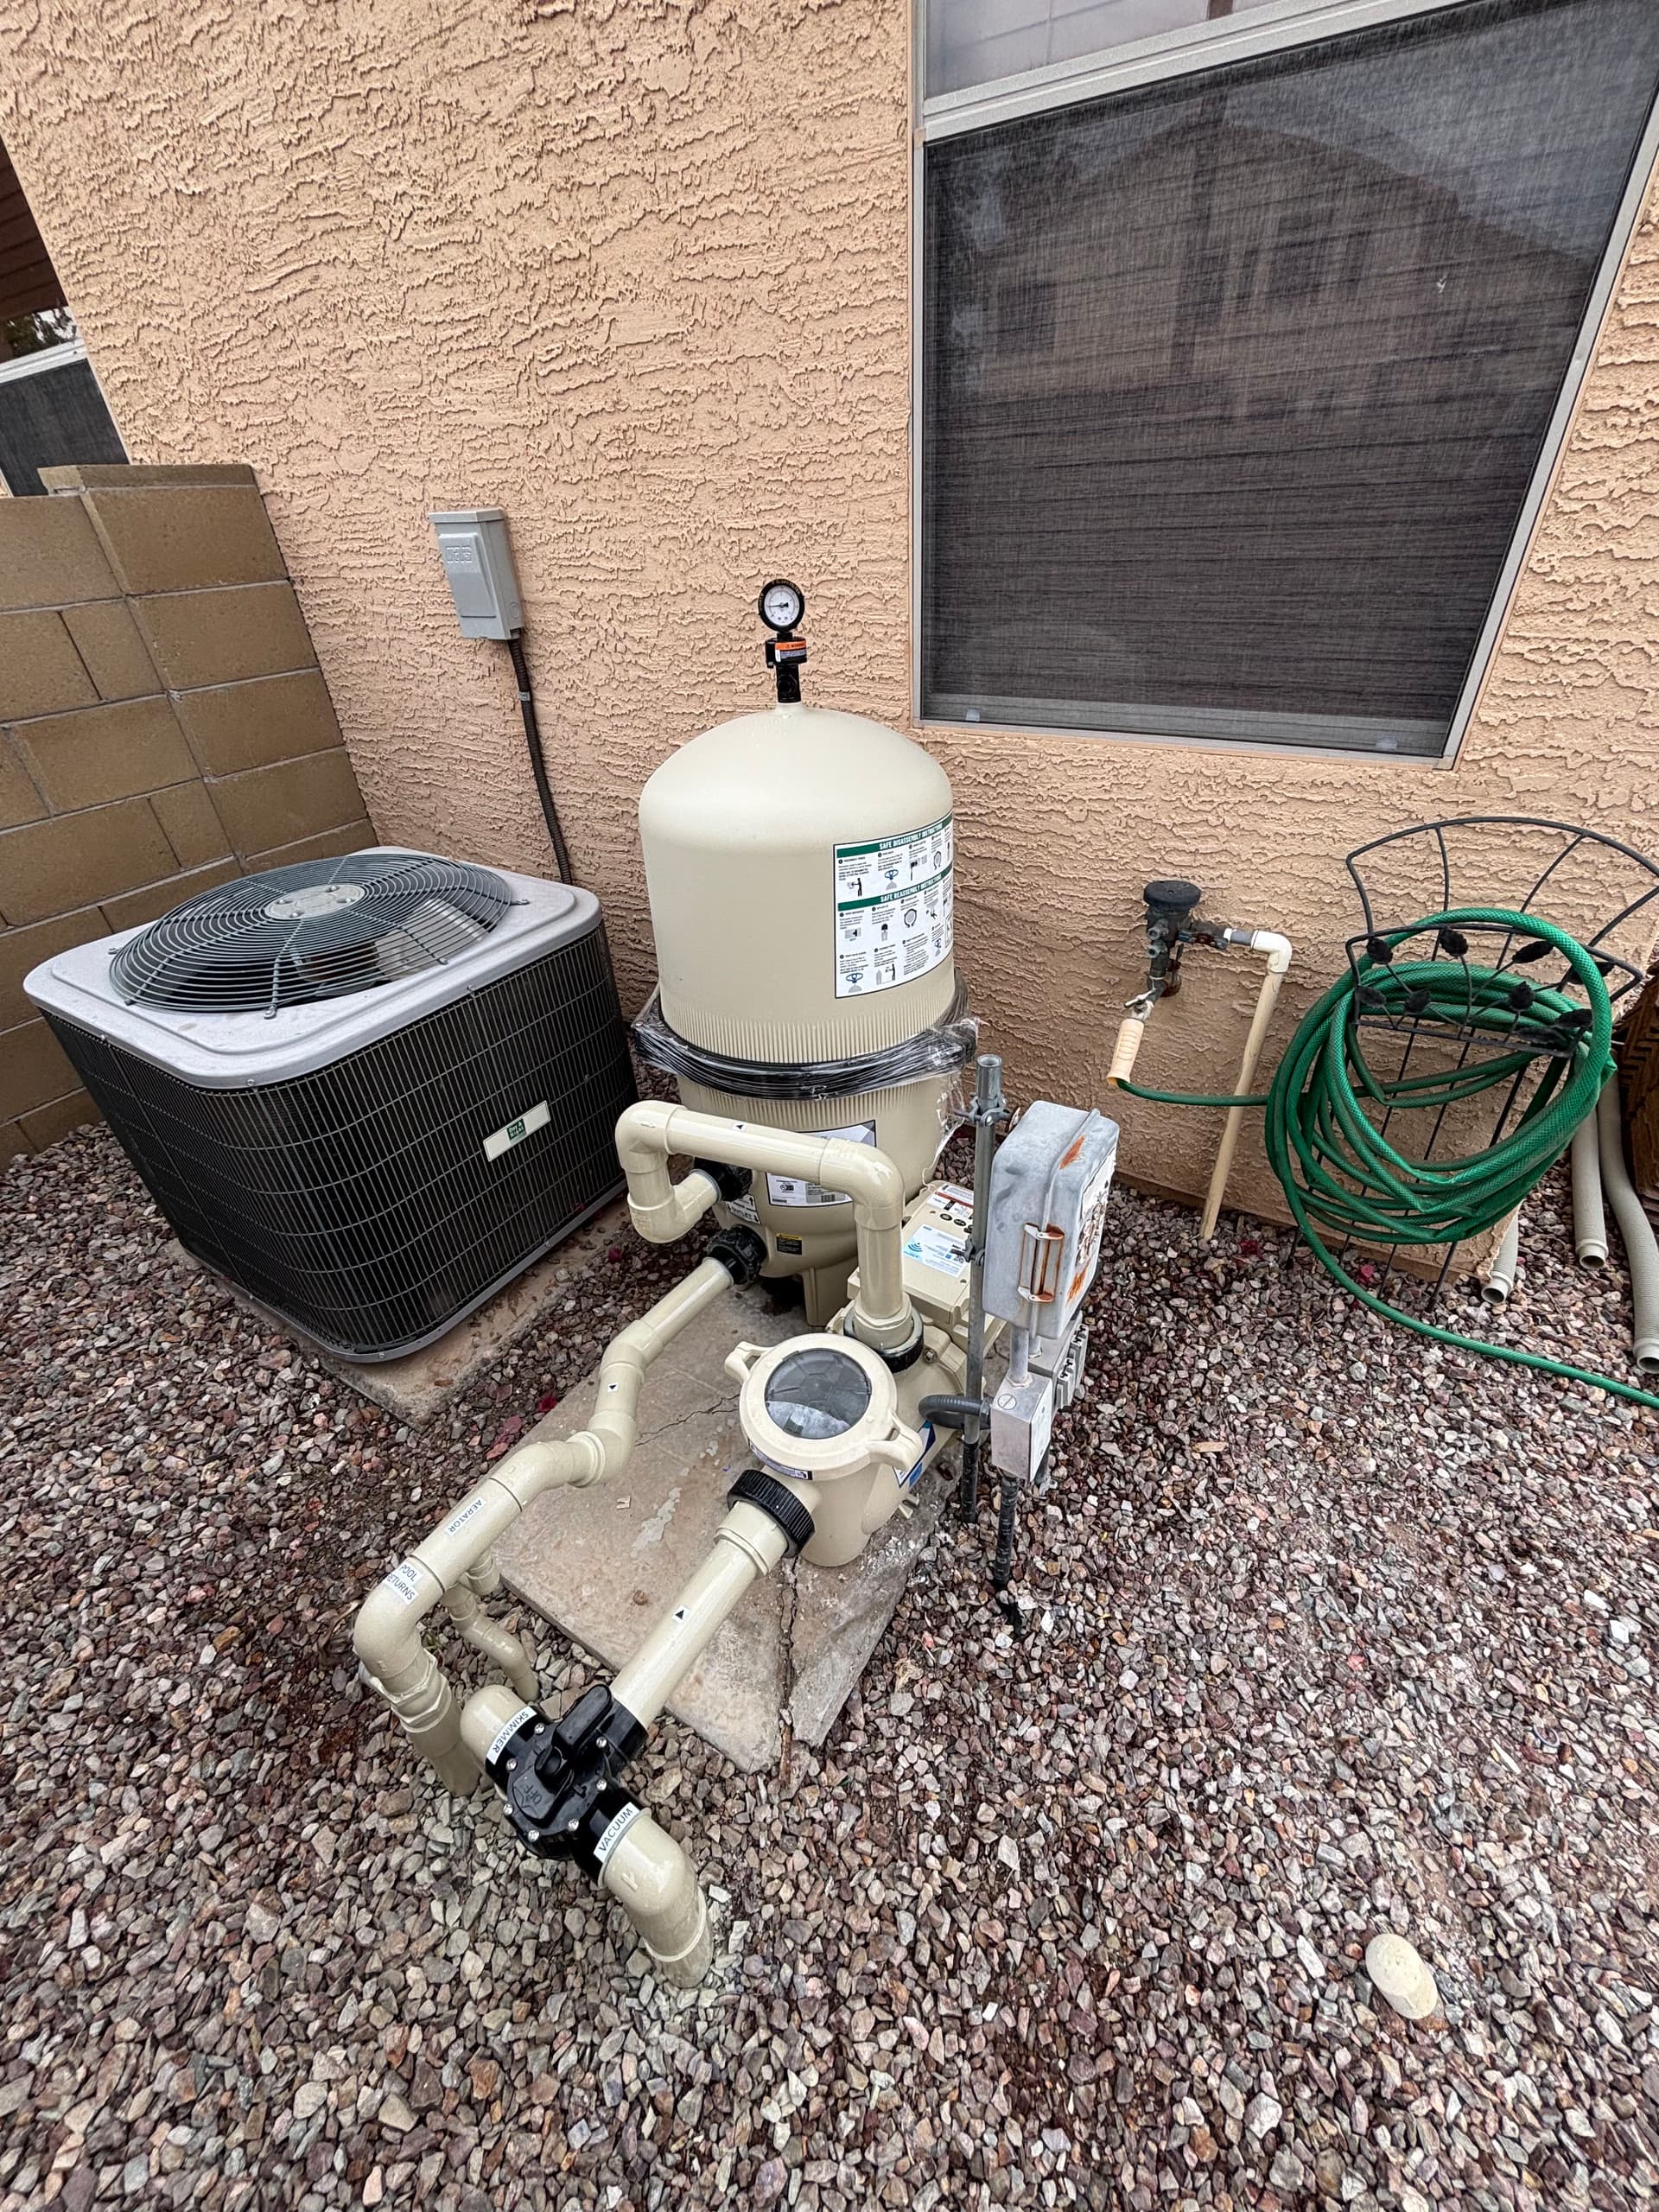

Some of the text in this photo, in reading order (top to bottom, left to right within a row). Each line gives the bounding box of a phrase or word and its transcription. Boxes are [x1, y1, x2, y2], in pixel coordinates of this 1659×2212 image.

[893, 833, 922, 847] DISASSEMBLY
[880, 894, 893, 903] SAFE
[893, 886, 921, 899] REASSEMBLY
[448, 1499, 482, 1533] AERATOR
[399, 1564, 417, 1582] POOL
[493, 1711, 530, 1754] SKIMMER
[523, 1785, 543, 1805] OFF
[598, 1808, 634, 1853] VACUUM
